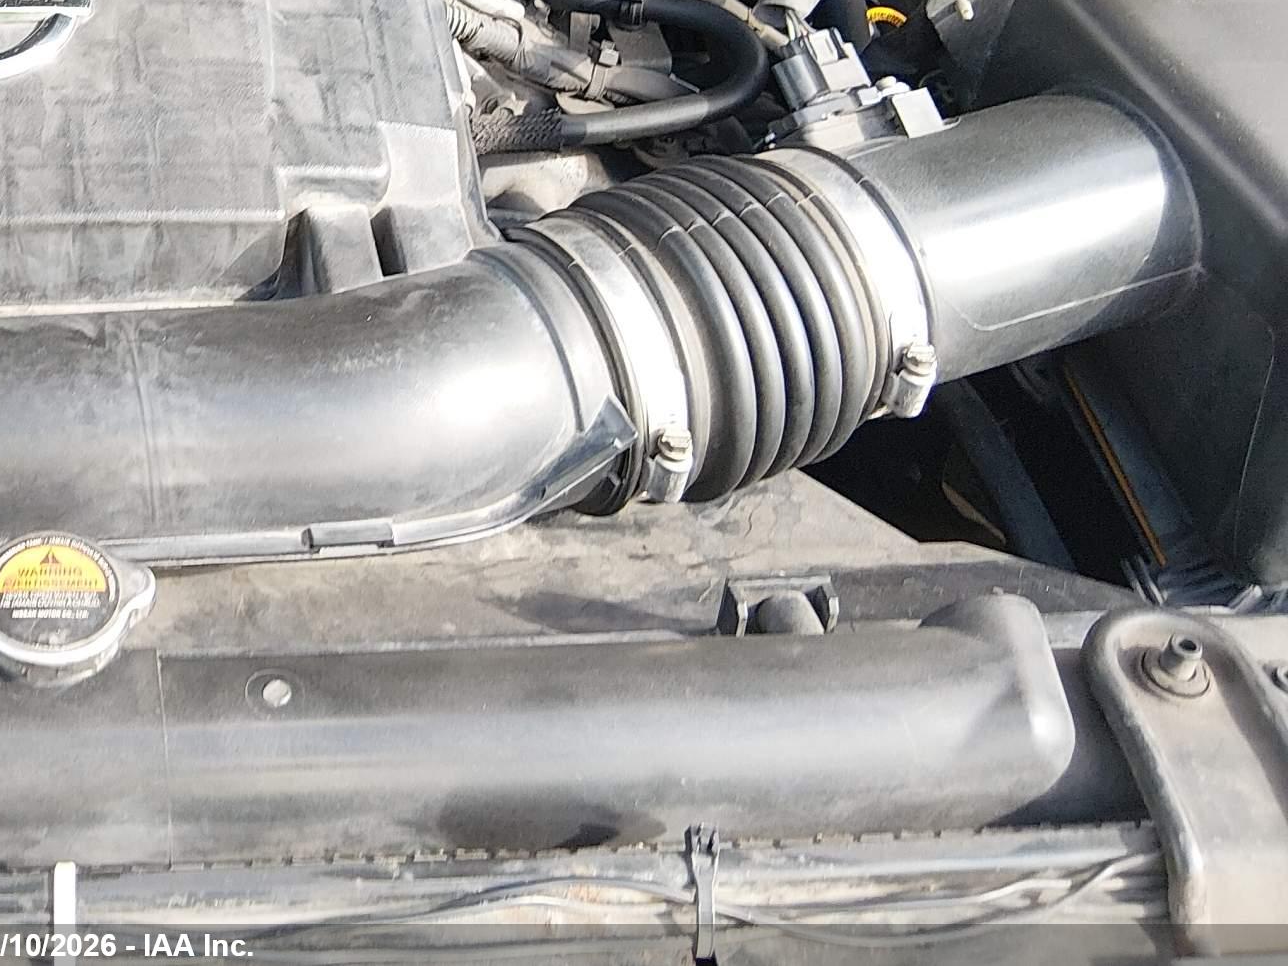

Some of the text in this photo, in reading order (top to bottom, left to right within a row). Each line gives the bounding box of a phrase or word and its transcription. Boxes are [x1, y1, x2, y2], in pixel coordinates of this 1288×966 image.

[17, 566, 84, 577] WARNING
[12, 609, 37, 619] NISSAN
[38, 609, 61, 619] MOTOR
